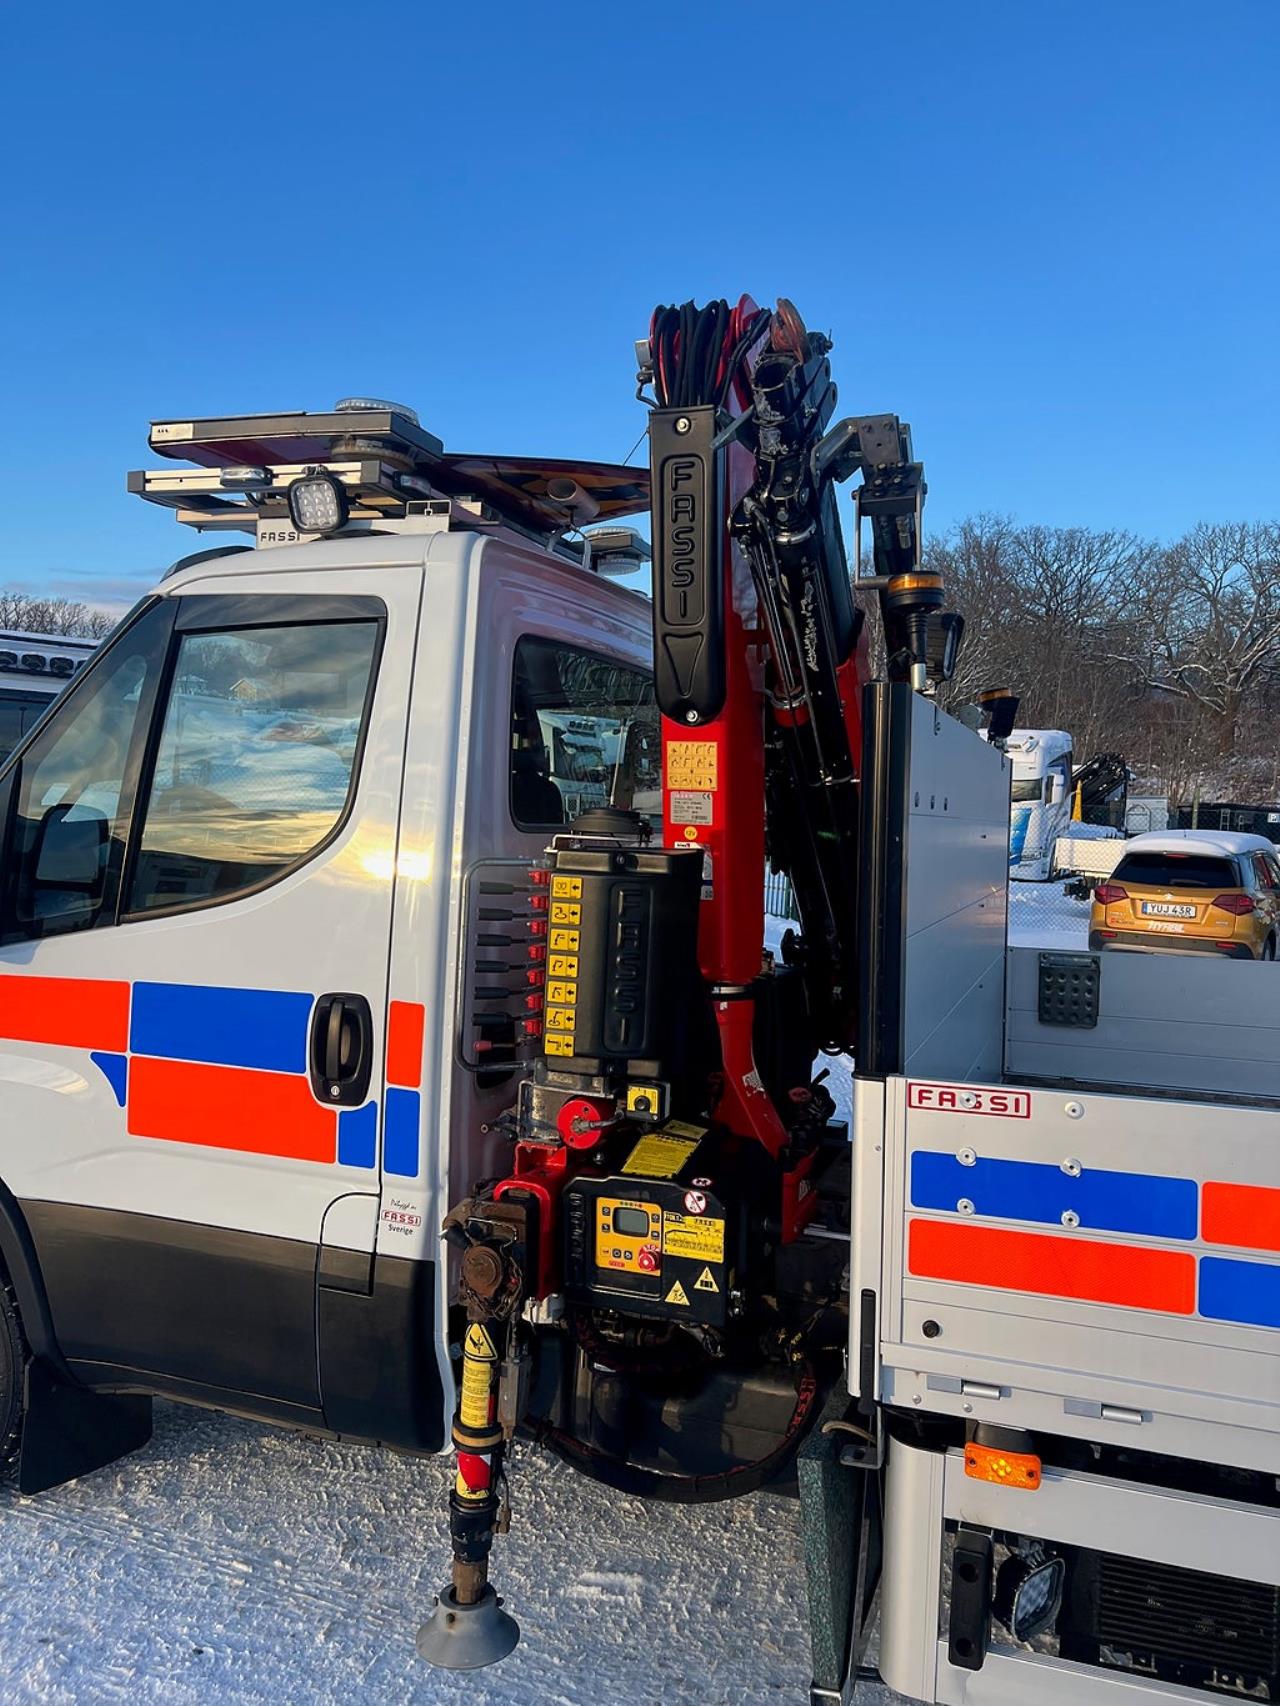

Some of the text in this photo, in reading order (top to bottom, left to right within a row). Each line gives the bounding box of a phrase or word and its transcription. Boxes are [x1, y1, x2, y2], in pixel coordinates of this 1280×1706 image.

[260, 531, 300, 542] FASSI
[671, 460, 696, 619] FASSI
[1150, 903, 1170, 914] YUJ
[384, 1211, 419, 1225] FASSI
[388, 1223, 414, 1236] Sverige
